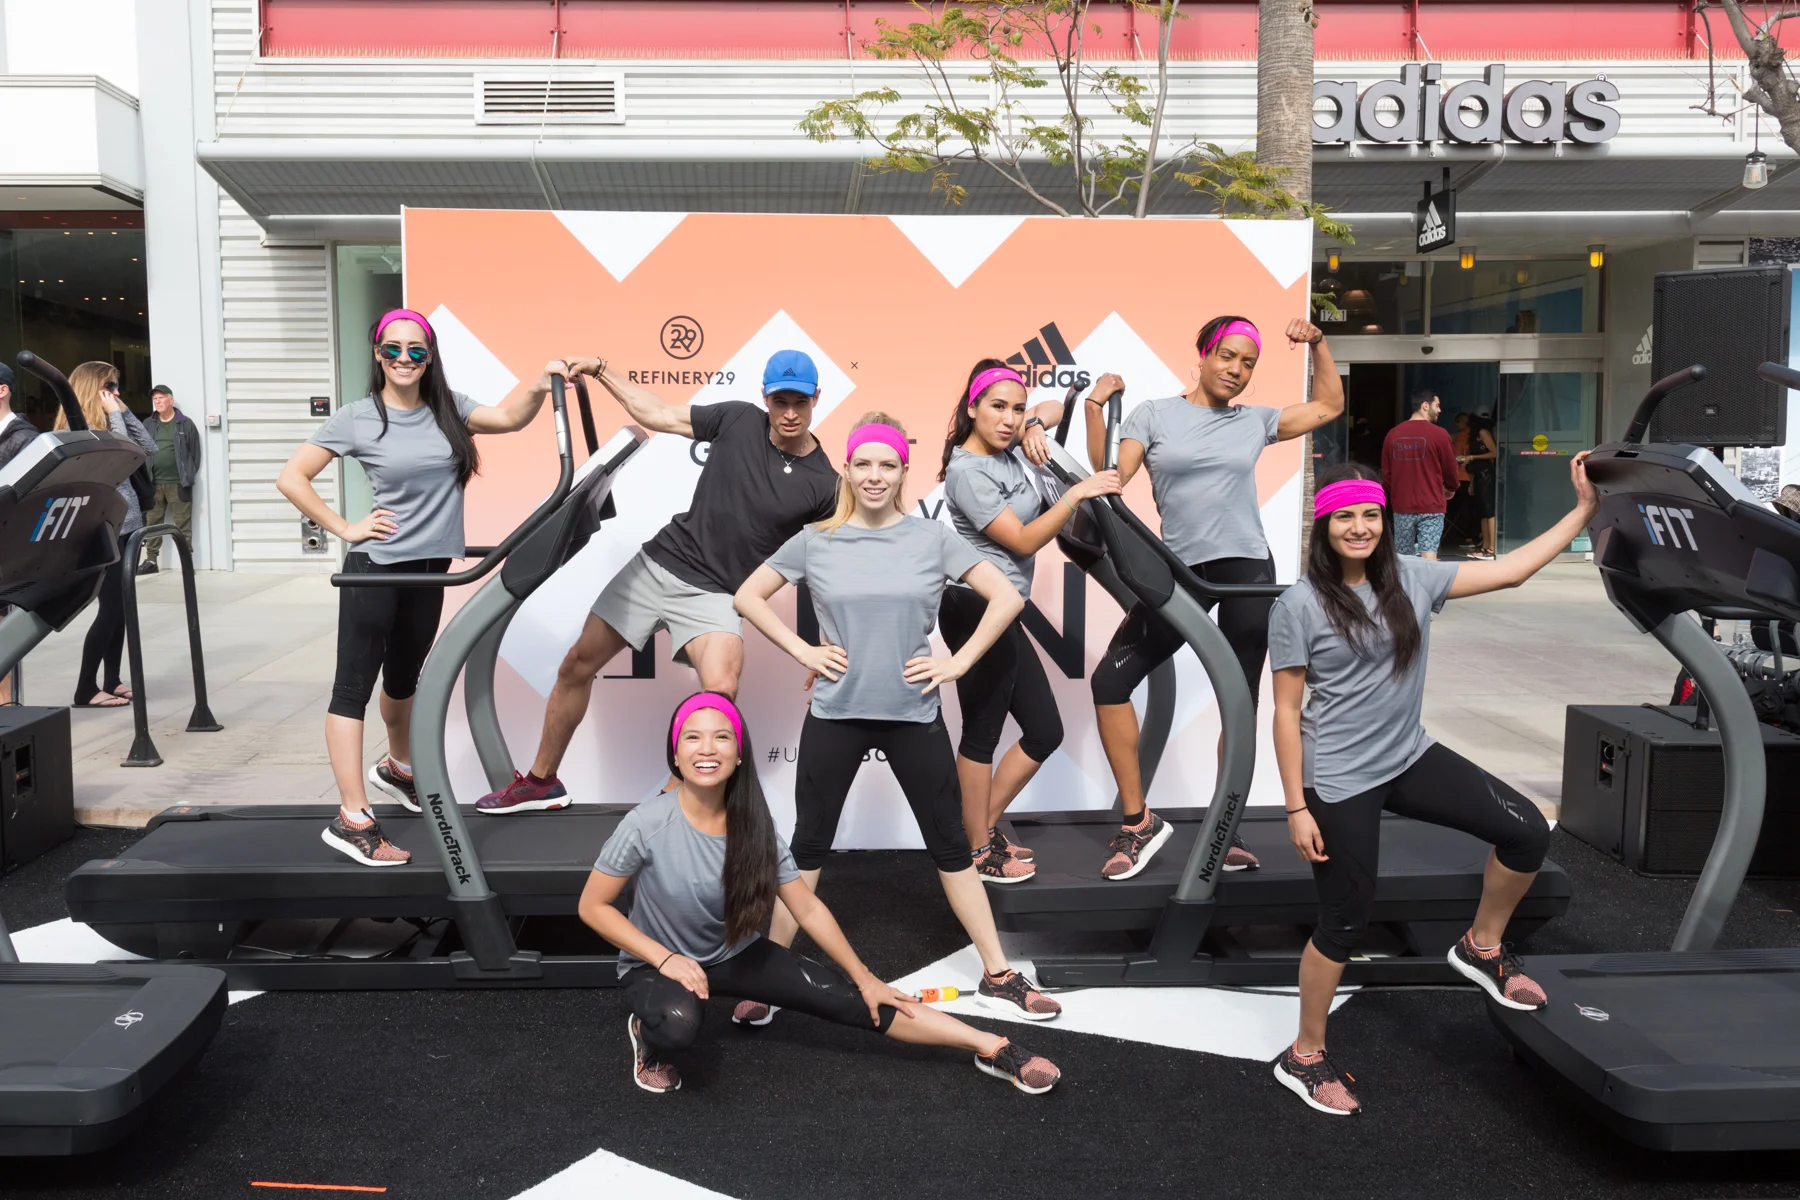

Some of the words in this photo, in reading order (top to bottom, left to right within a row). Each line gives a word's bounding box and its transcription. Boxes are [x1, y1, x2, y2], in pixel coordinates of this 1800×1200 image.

[1312, 63, 1620, 143] adidas
[1418, 224, 1447, 247] adidas
[1322, 310, 1345, 321] 121
[1632, 350, 1653, 365] adid
[628, 370, 736, 385] REFINERY29
[1017, 364, 1092, 389] didas
[426, 792, 472, 886] NordicTrack
[1198, 790, 1241, 884] NordicTrack
